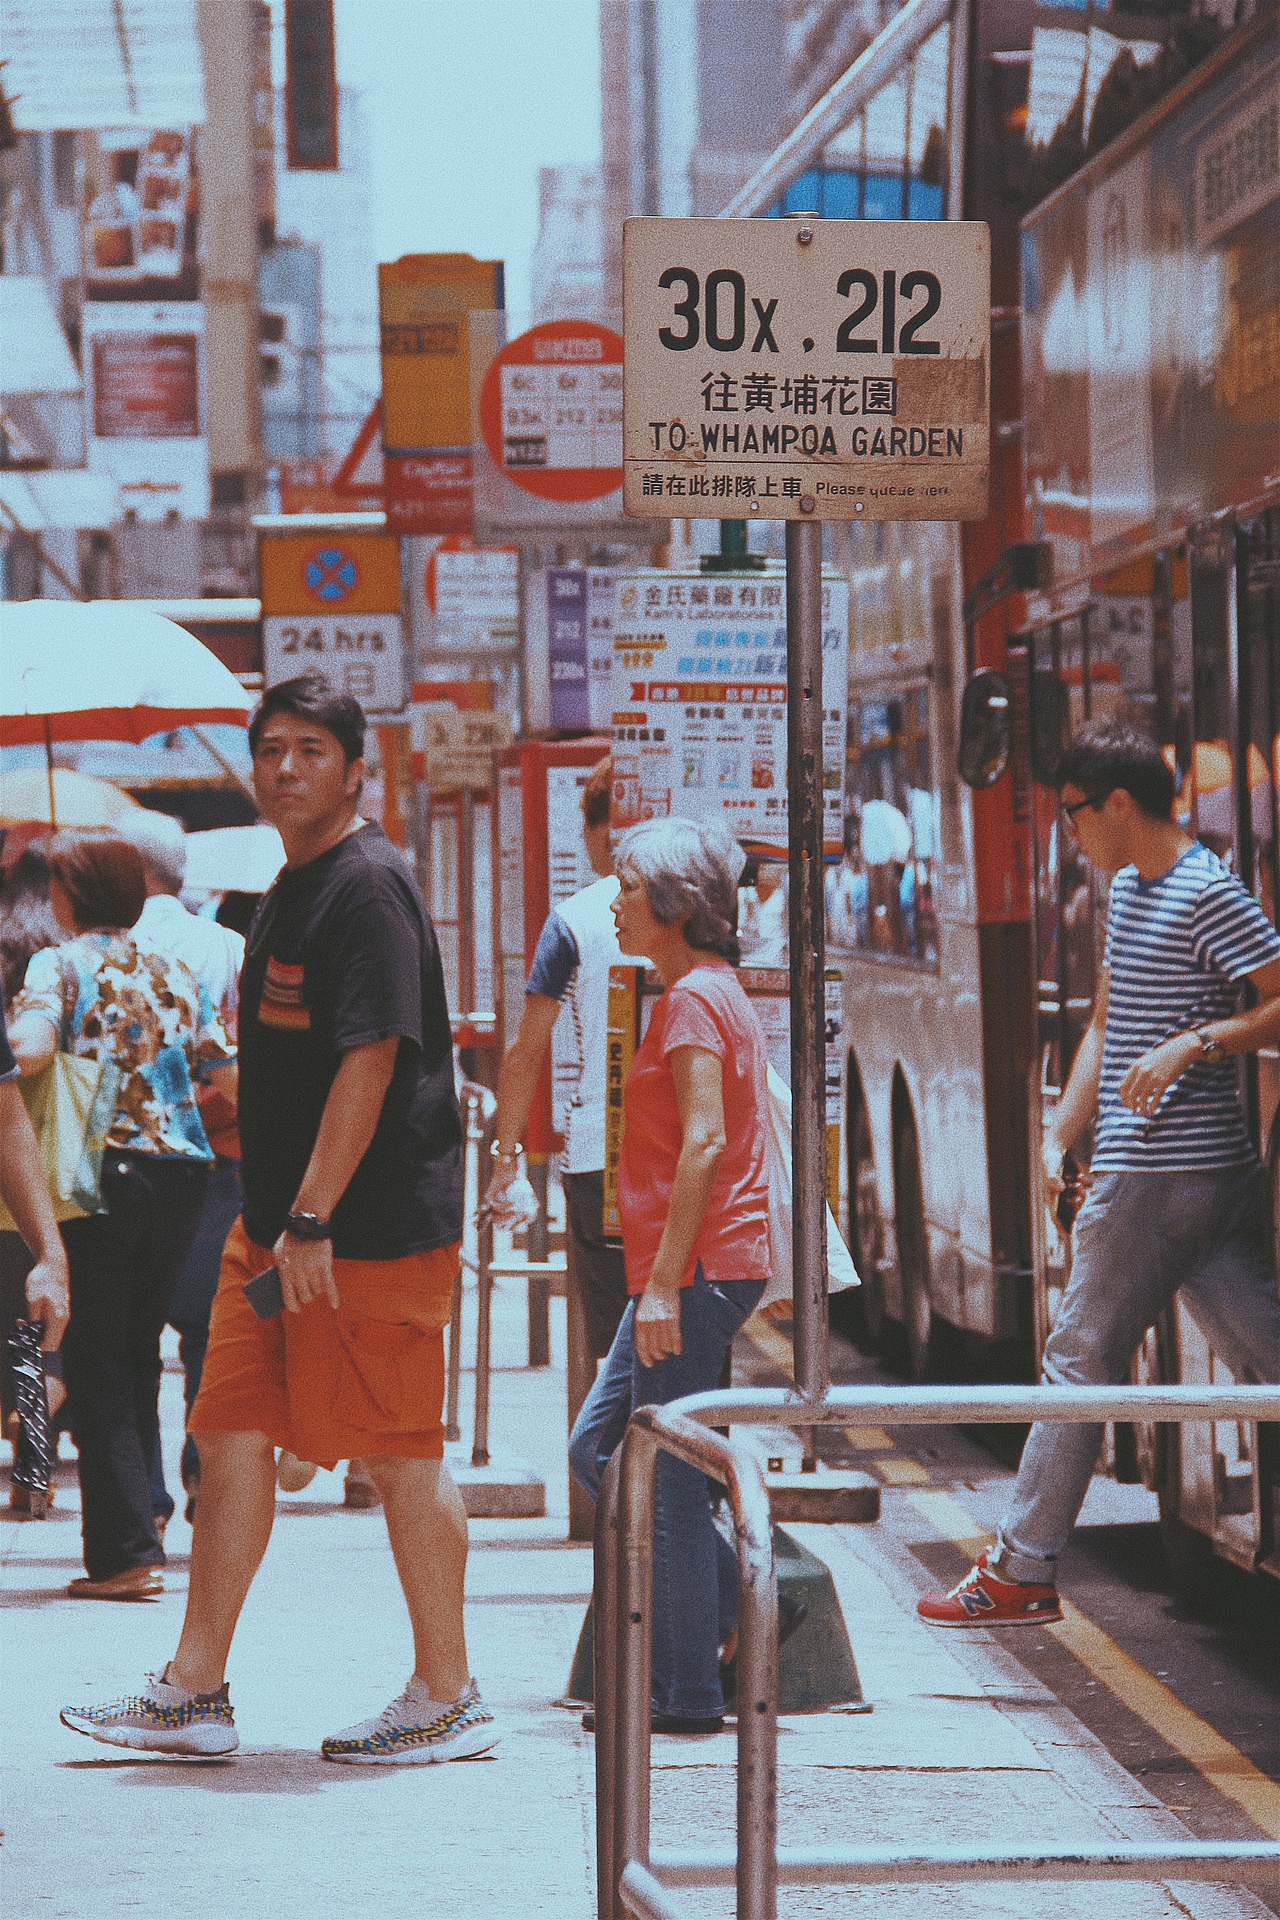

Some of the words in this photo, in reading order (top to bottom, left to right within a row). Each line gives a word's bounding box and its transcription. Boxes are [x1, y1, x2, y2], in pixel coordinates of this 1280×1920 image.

[657, 265, 779, 353] 30x
[836, 267, 942, 354] 212
[700, 371, 898, 416] 往黃埔花園
[700, 423, 838, 456] WHAMPOA
[852, 425, 963, 457] GARDEN
[642, 474, 803, 498] 請在此排隊上車
[815, 481, 866, 496] Please
[280, 628, 323, 654] 24
[335, 629, 384, 652] hrs
[958, 1586, 996, 1617] N
